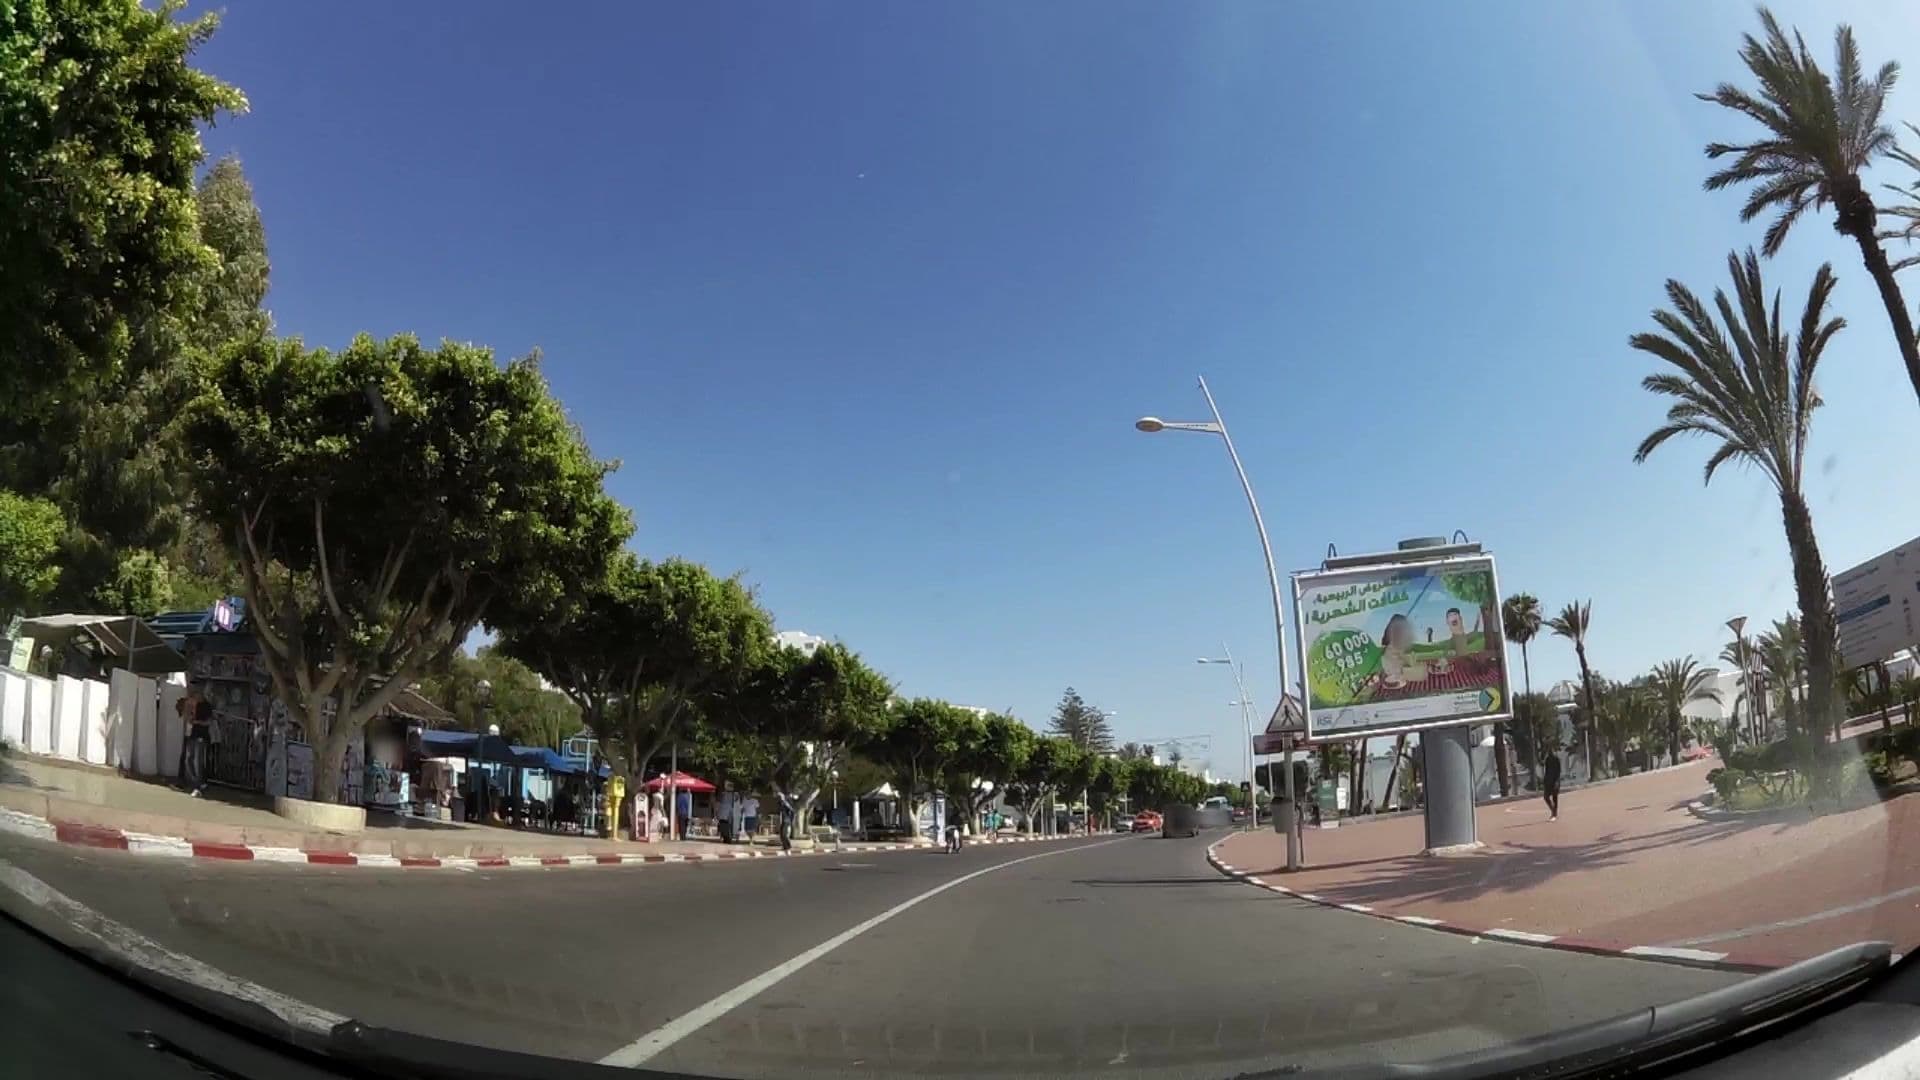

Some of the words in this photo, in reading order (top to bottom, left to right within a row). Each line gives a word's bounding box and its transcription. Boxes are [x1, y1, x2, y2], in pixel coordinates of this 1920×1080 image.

[1325, 641, 1342, 660] 60
[1343, 632, 1369, 651] 000
[1337, 652, 1363, 672] 985
